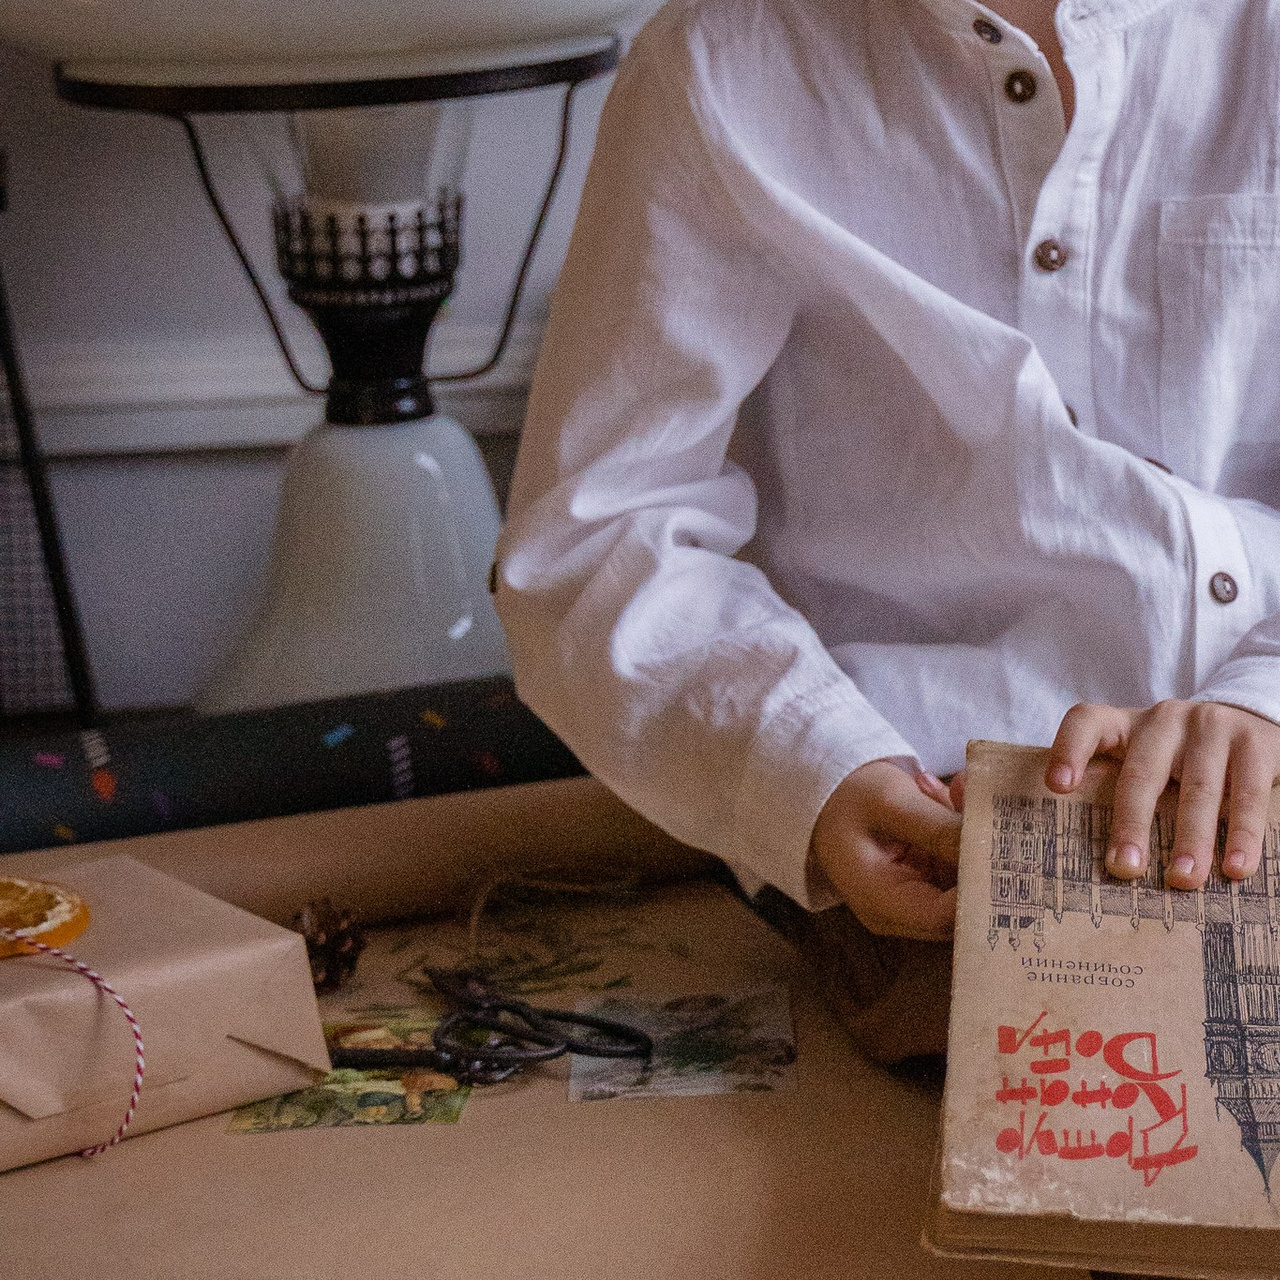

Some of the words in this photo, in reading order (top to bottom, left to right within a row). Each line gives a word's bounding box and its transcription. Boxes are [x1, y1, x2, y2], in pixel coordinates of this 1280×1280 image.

[1021, 957, 1143, 976] сочинений
[1027, 971, 1135, 988] собрание
[998, 1011, 1183, 1081] Дойл
[995, 1076, 1188, 1132] Конан
[996, 1111, 1198, 1187] Артур
